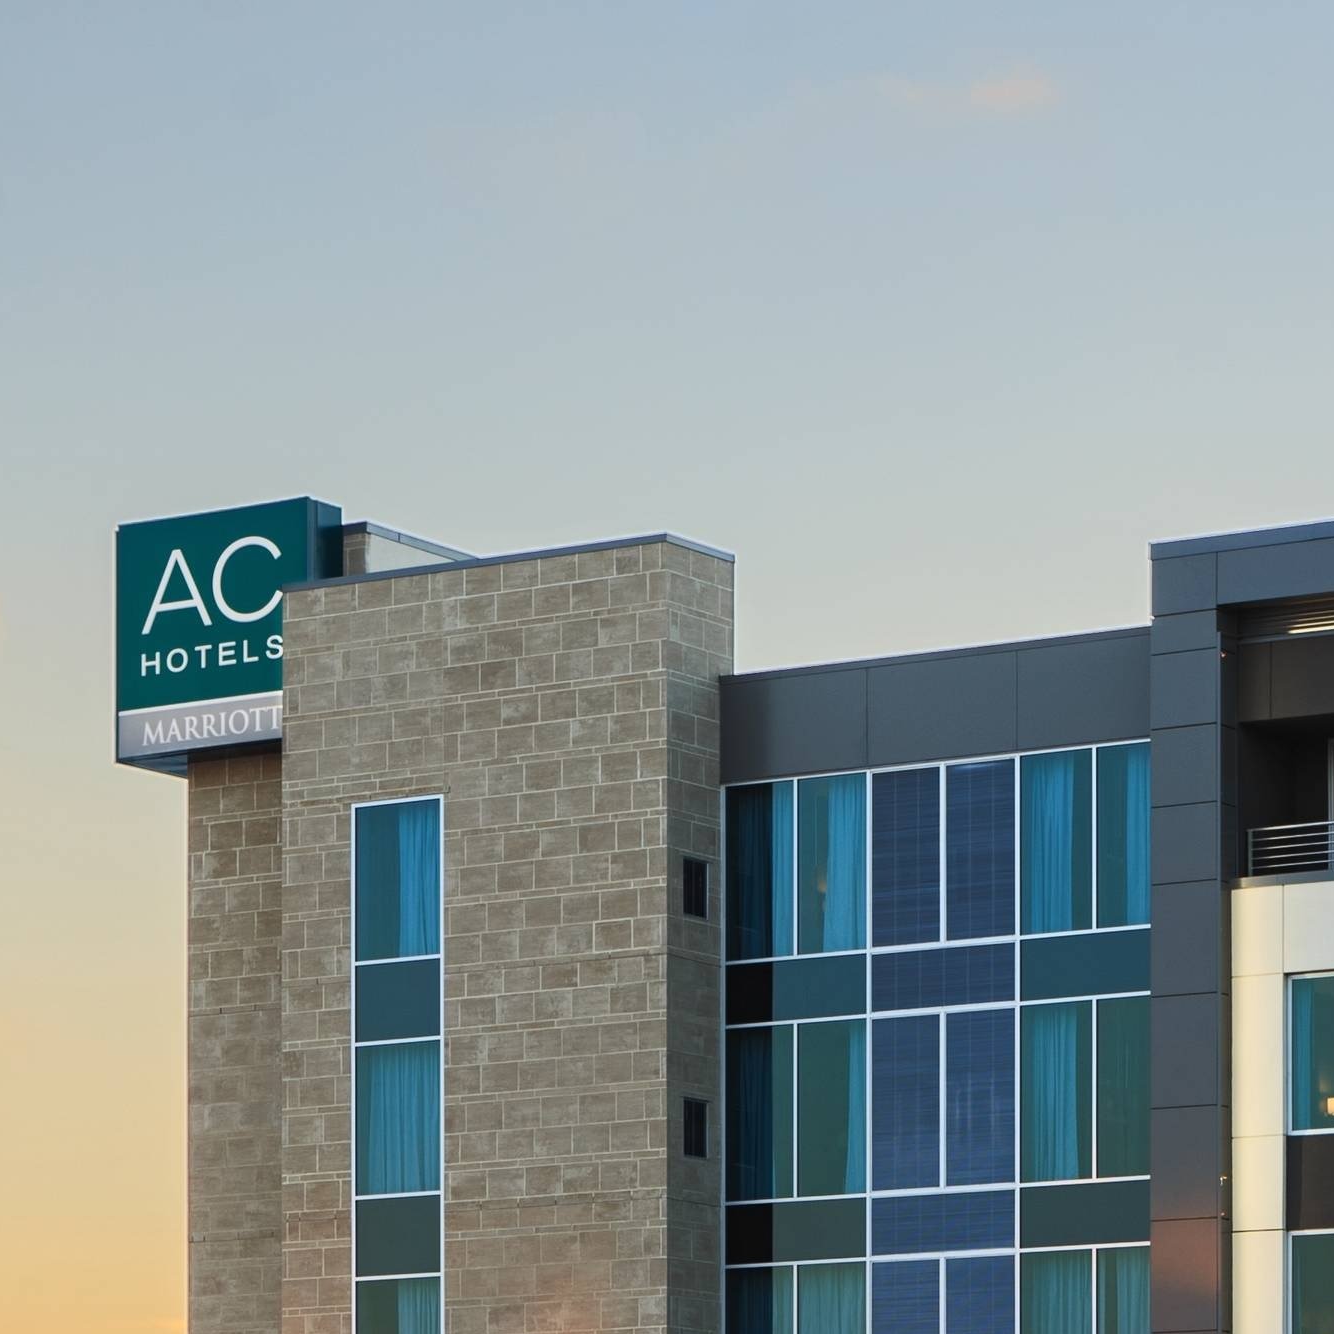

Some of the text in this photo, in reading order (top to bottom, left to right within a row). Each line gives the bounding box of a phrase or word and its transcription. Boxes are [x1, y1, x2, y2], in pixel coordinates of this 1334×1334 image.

[141, 535, 284, 636] AC
[140, 634, 284, 677] HOTELS
[142, 705, 284, 747] MARRIOTT
